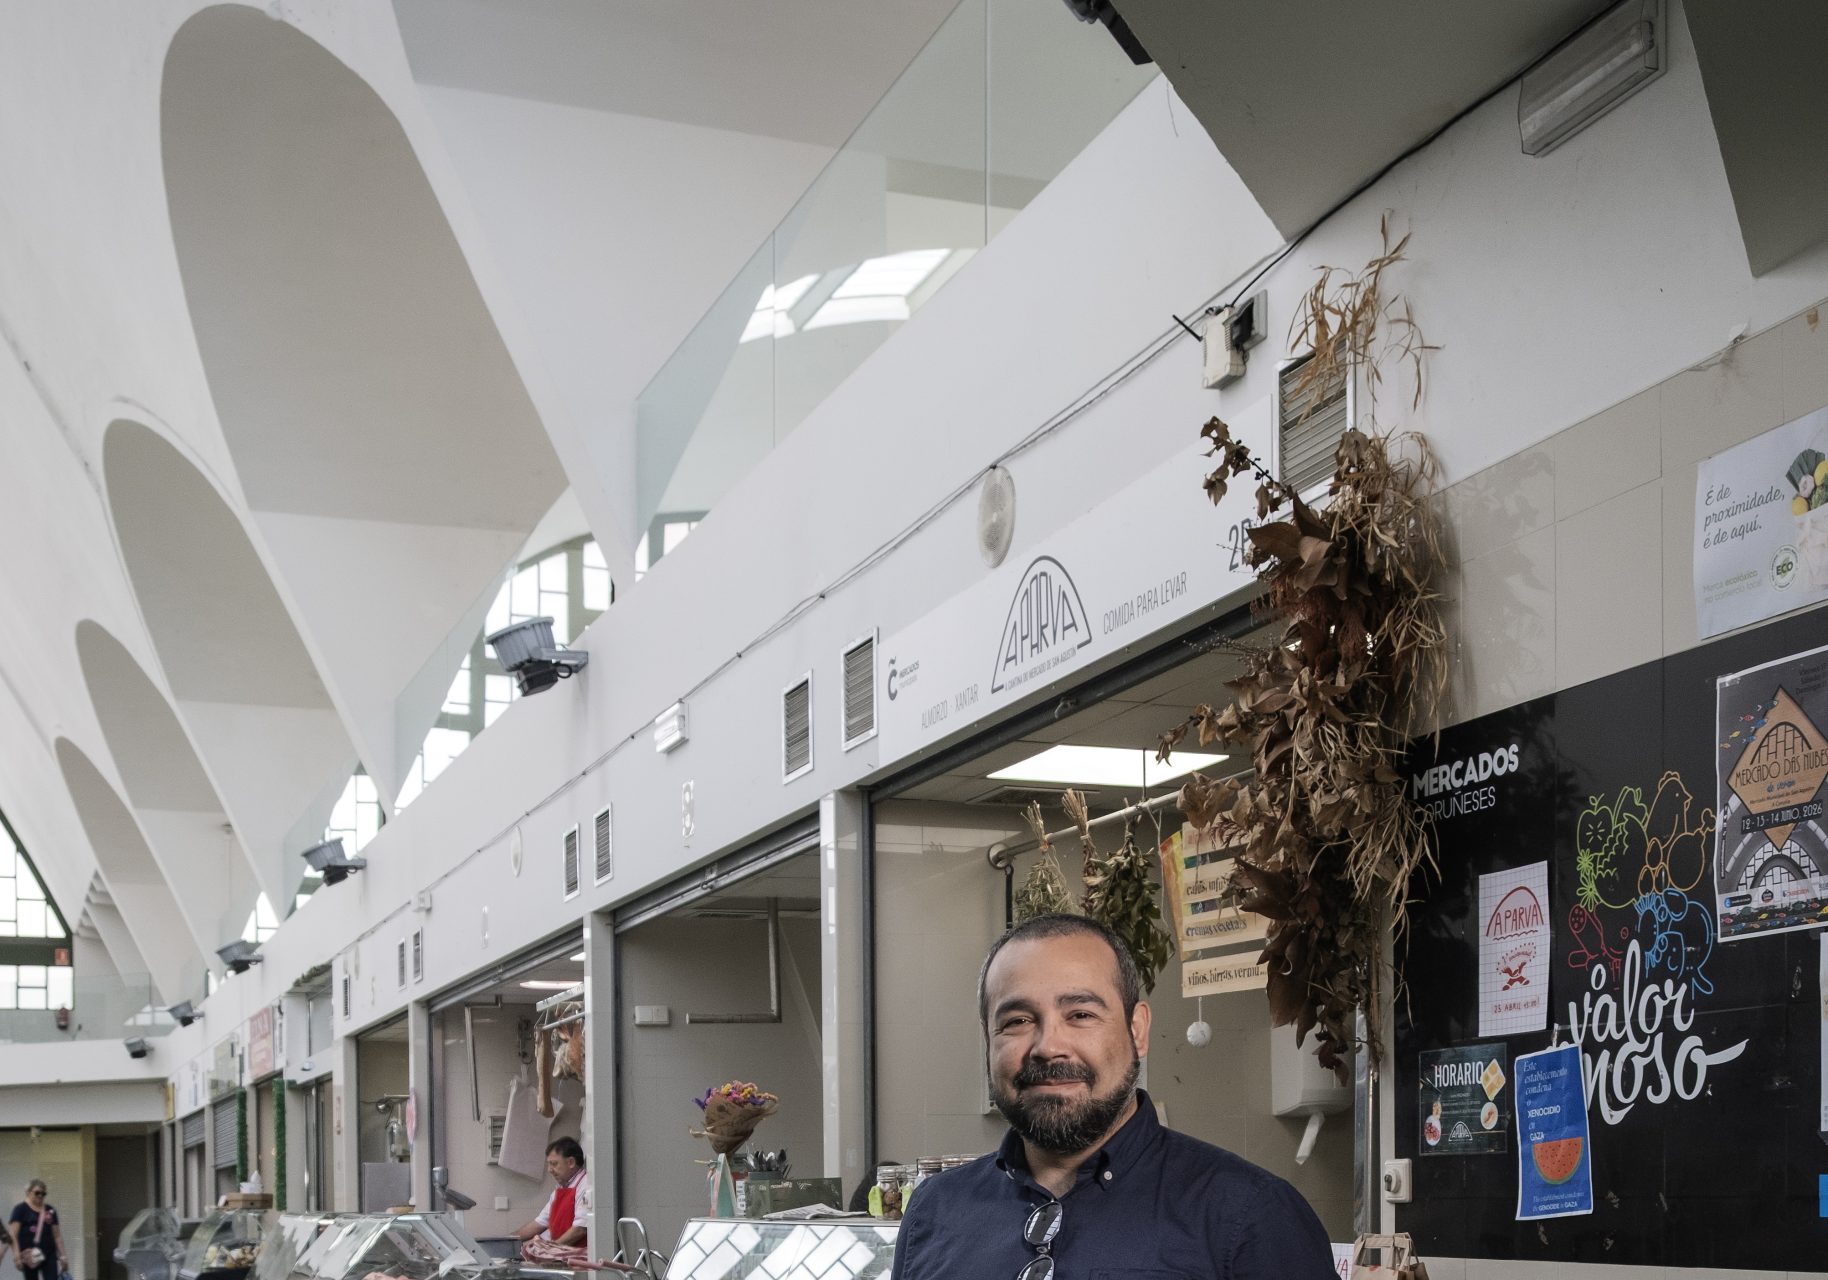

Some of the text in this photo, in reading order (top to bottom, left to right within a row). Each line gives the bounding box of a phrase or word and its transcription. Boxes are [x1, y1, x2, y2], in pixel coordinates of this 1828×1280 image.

[1716, 484, 1731, 502] de
[1703, 485, 1785, 532] proximidade,
[1713, 528, 1729, 546] de
[1730, 514, 1762, 541] aquí.
[1775, 561, 1794, 576] ECO
[1103, 571, 1187, 635] COMIDA PARA LEVAR
[921, 684, 979, 728] ALMORZO XANTAR
[1412, 743, 1519, 800] MERCADOS
[1734, 748, 1828, 787] MERCADO DAS NUBES
[1802, 803, 1823, 818] 2026
[1568, 939, 1695, 1050] valor
[1434, 1060, 1485, 1089] HORARIO
[1525, 1082, 1552, 1095] condena
[1527, 1105, 1561, 1118] XENOCIDIO
[1529, 1131, 1545, 1141] GAZA
[1538, 1203, 1560, 1212] GENOCIDE
[1564, 1200, 1578, 1209] GAZA
